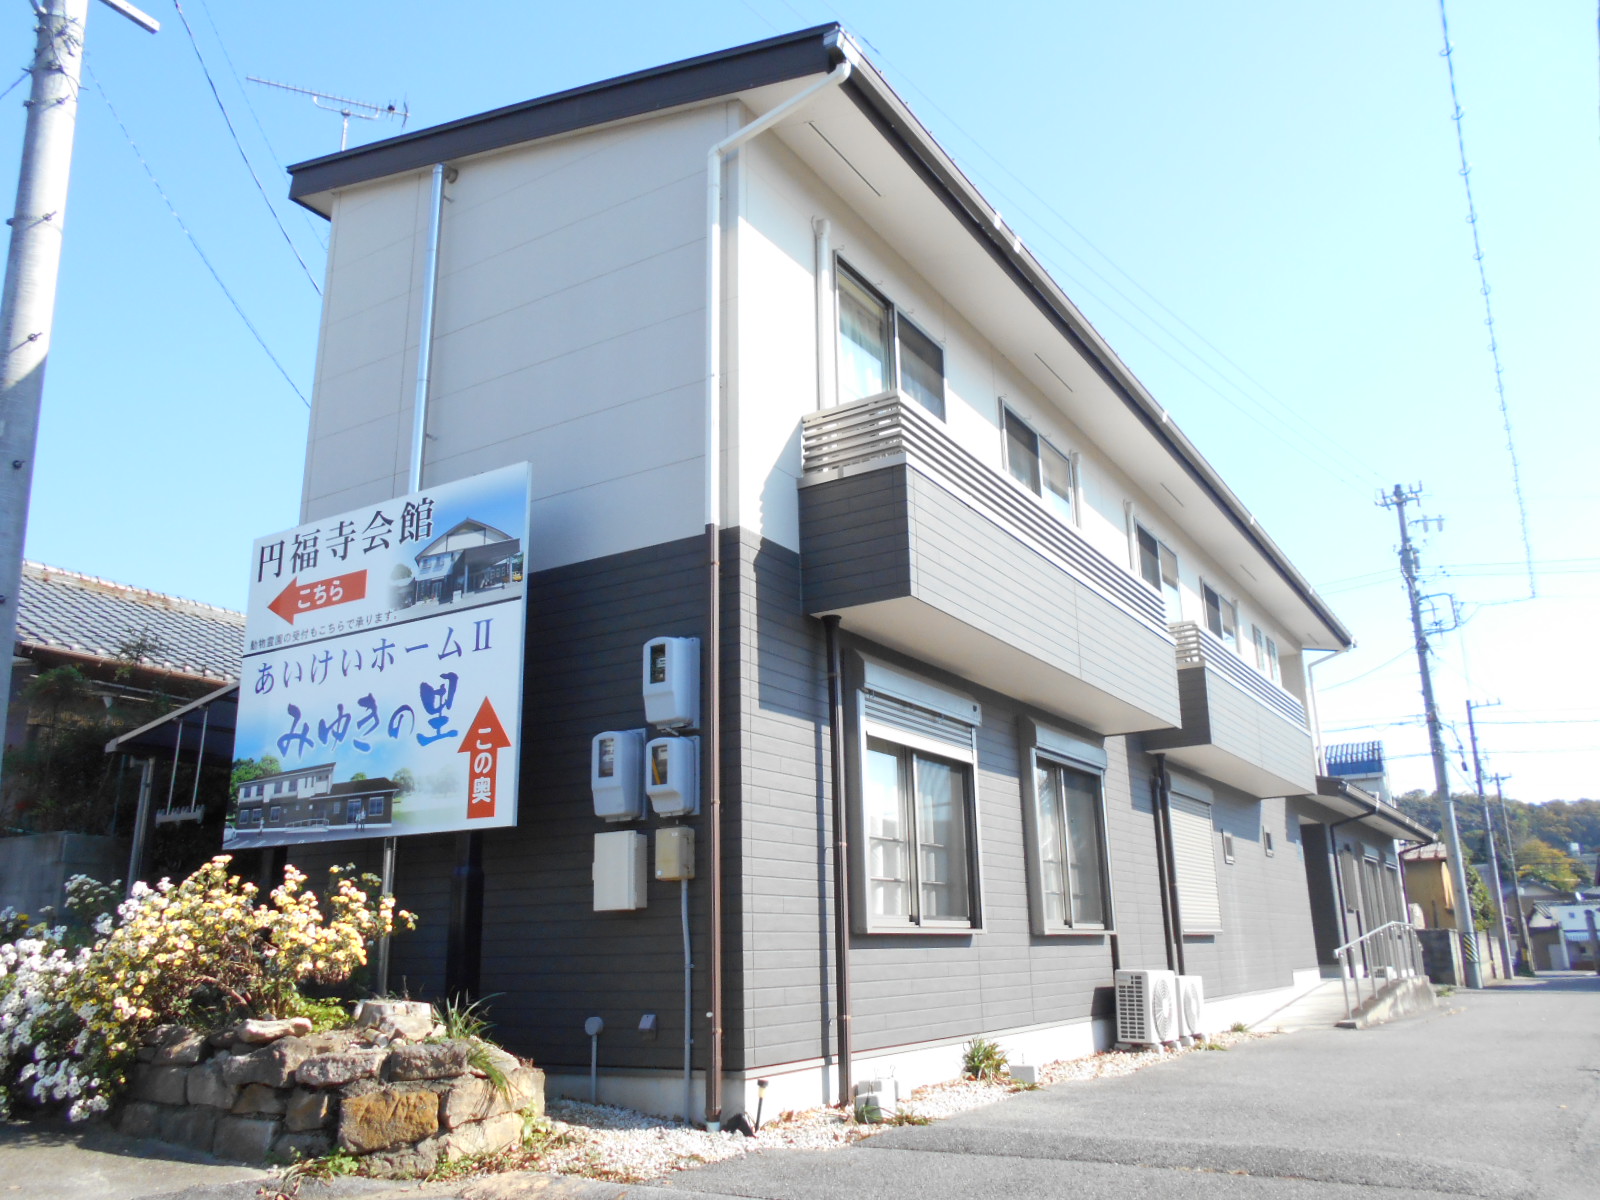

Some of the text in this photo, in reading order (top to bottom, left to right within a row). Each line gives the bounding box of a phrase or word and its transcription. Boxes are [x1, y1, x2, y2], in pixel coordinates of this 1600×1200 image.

[258, 497, 434, 582] 円福寺会館
[297, 580, 343, 609] こちら
[276, 672, 459, 757] みゆきの里
[472, 727, 493, 804] この奥
